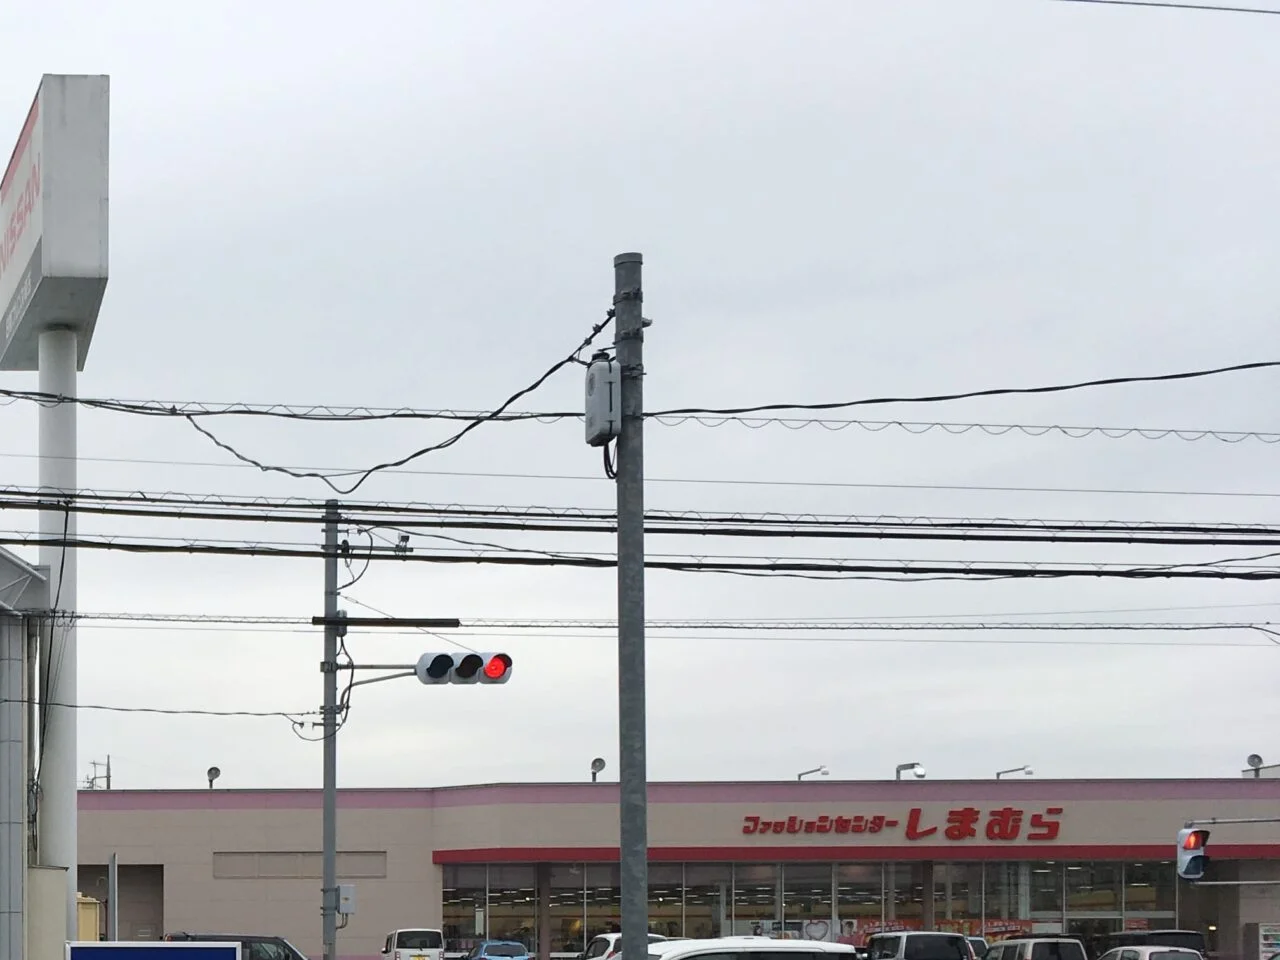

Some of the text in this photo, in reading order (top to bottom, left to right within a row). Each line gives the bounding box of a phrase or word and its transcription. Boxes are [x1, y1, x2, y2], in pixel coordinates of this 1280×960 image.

[742, 807, 1065, 840] ファッションセンター しまむら
